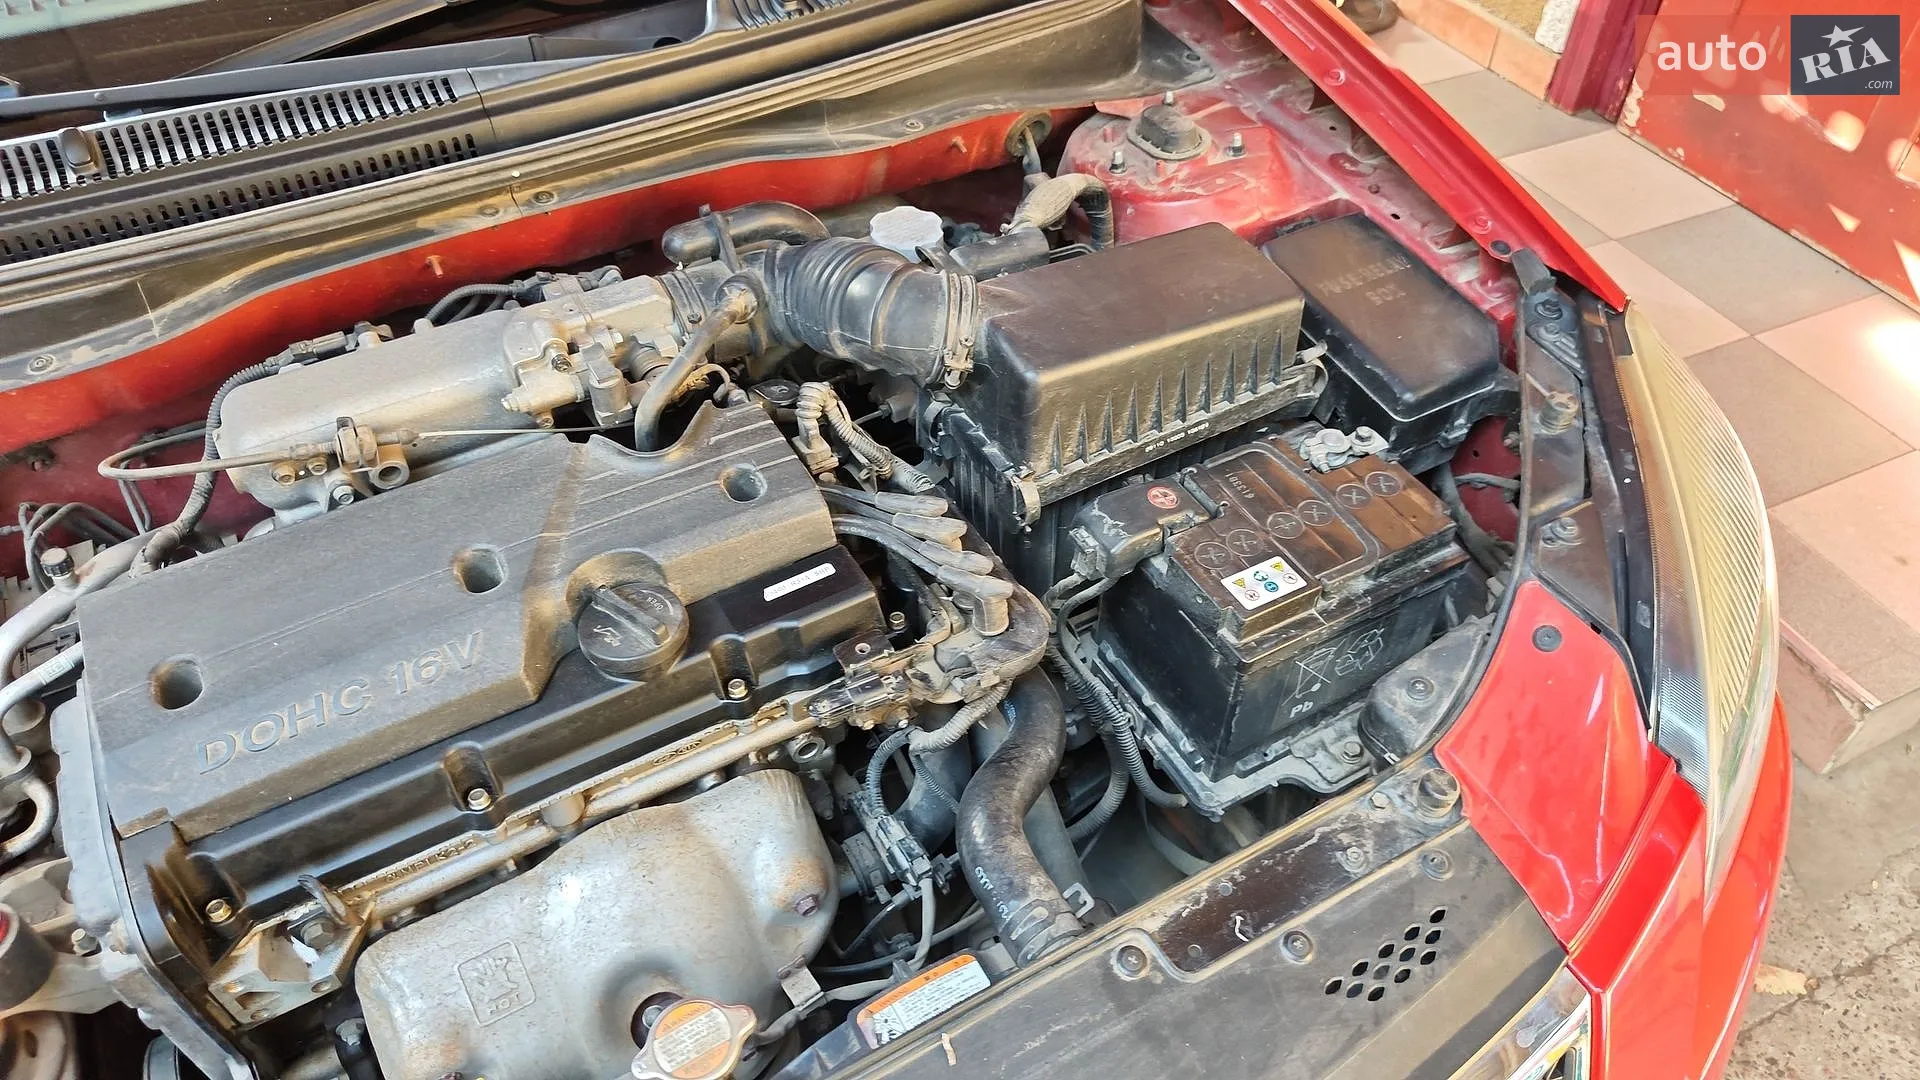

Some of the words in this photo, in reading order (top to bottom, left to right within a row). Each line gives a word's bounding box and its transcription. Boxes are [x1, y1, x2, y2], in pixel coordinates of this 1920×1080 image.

[196, 678, 373, 775] DOHC
[390, 629, 485, 696] 16V
[1289, 701, 1314, 719] Pb
